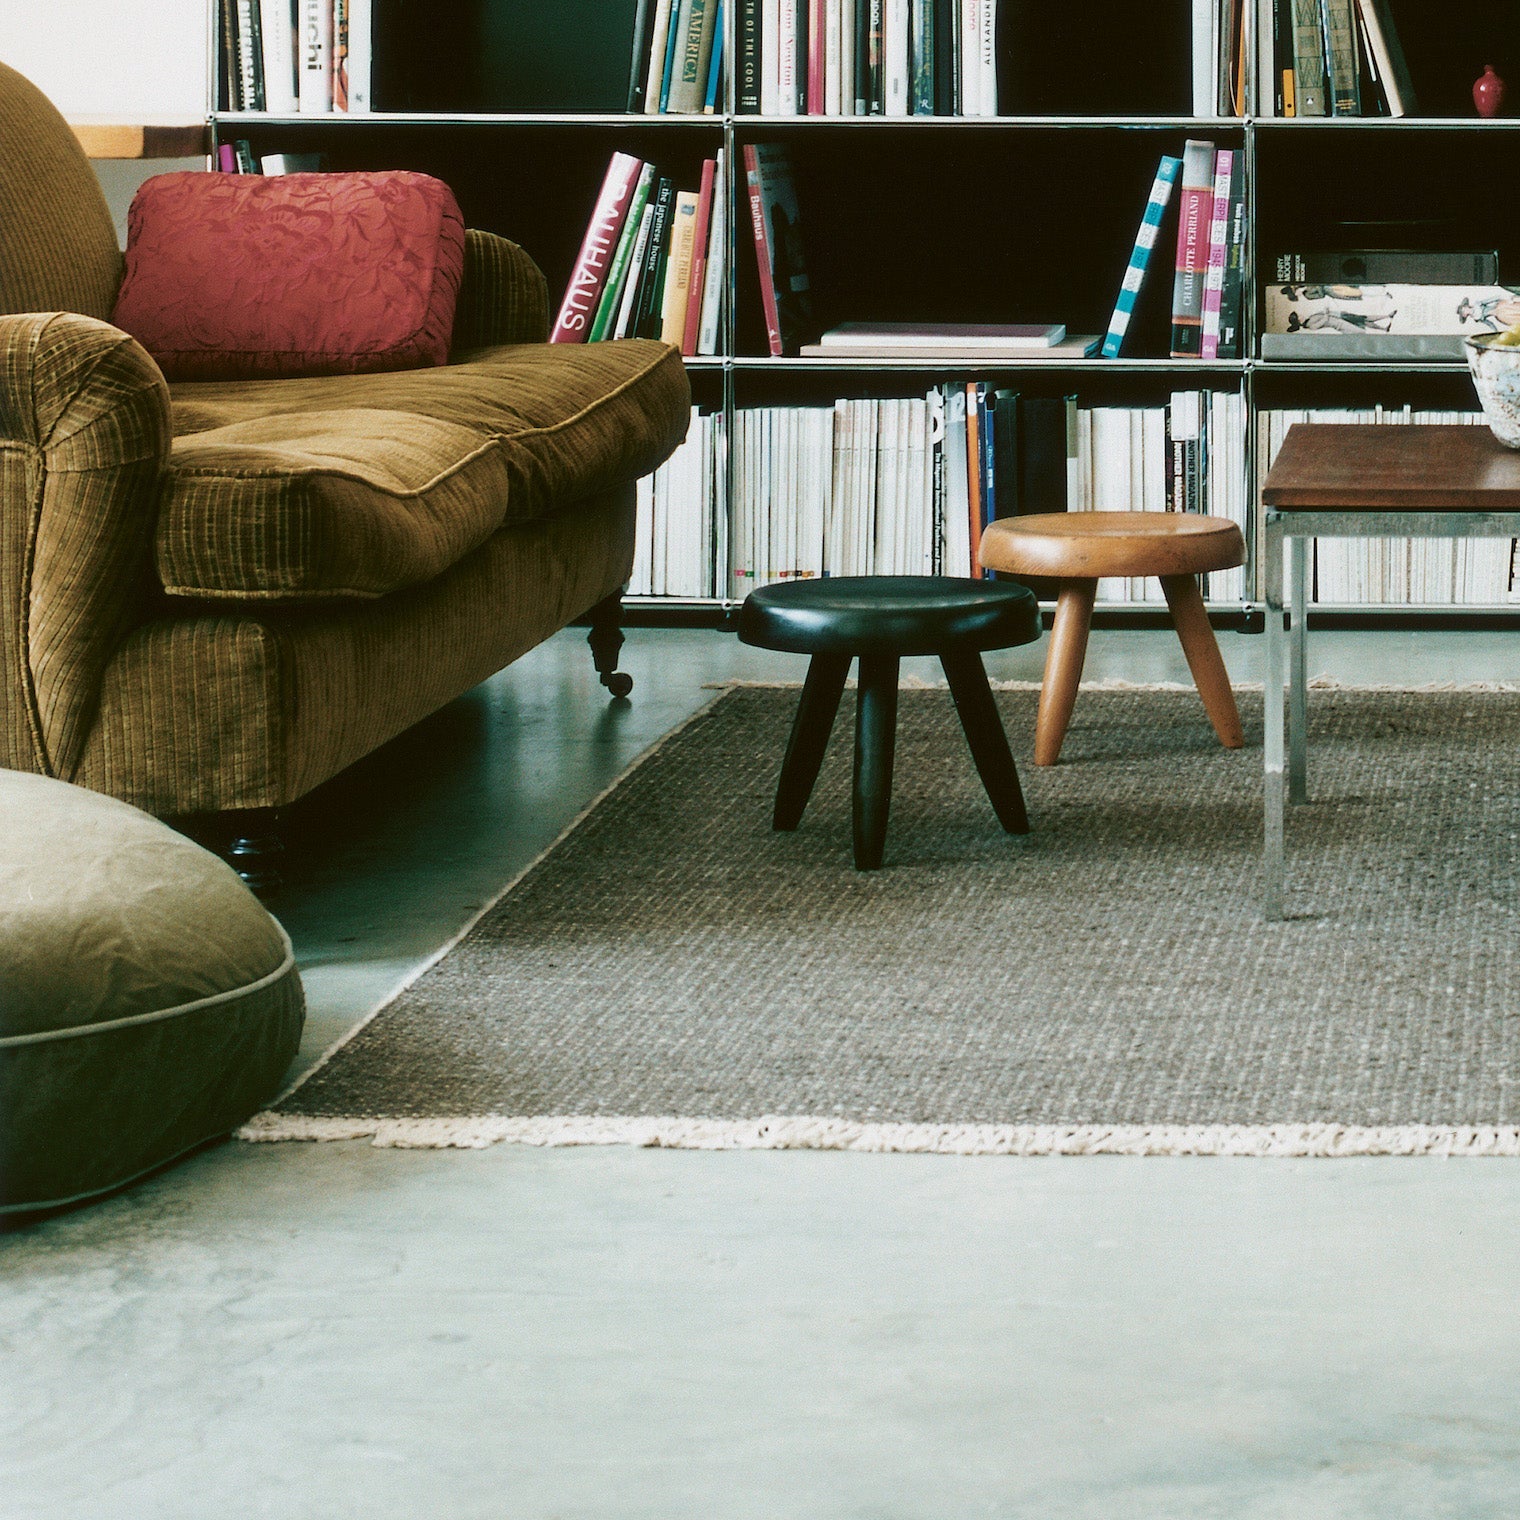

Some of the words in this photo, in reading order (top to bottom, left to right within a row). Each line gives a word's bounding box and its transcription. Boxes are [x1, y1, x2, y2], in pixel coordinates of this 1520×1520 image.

[746, 19, 755, 32] OF
[984, 0, 992, 66] ALEXANDRE
[683, 7, 704, 80] AMERICA
[745, 38, 755, 57] THE
[745, 61, 755, 89] COOL
[1162, 162, 1173, 175] 02
[1219, 156, 1230, 168] 01
[660, 188, 670, 203] the
[651, 203, 668, 244] japanese
[750, 195, 764, 241] Bauhaus
[1188, 194, 1199, 246] PERRIAND
[560, 183, 628, 332] BAUHAUS
[679, 224, 692, 258] CHARLOTTE
[648, 244, 660, 272] house
[1276, 257, 1284, 282] HENRY
[677, 260, 690, 290] PERRIAND
[1183, 247, 1196, 306] CHARLOTTE
[1174, 442, 1183, 475] ANOTHER
[1187, 439, 1196, 472] ANOTHER
[1187, 474, 1196, 510] MAGAZINE
